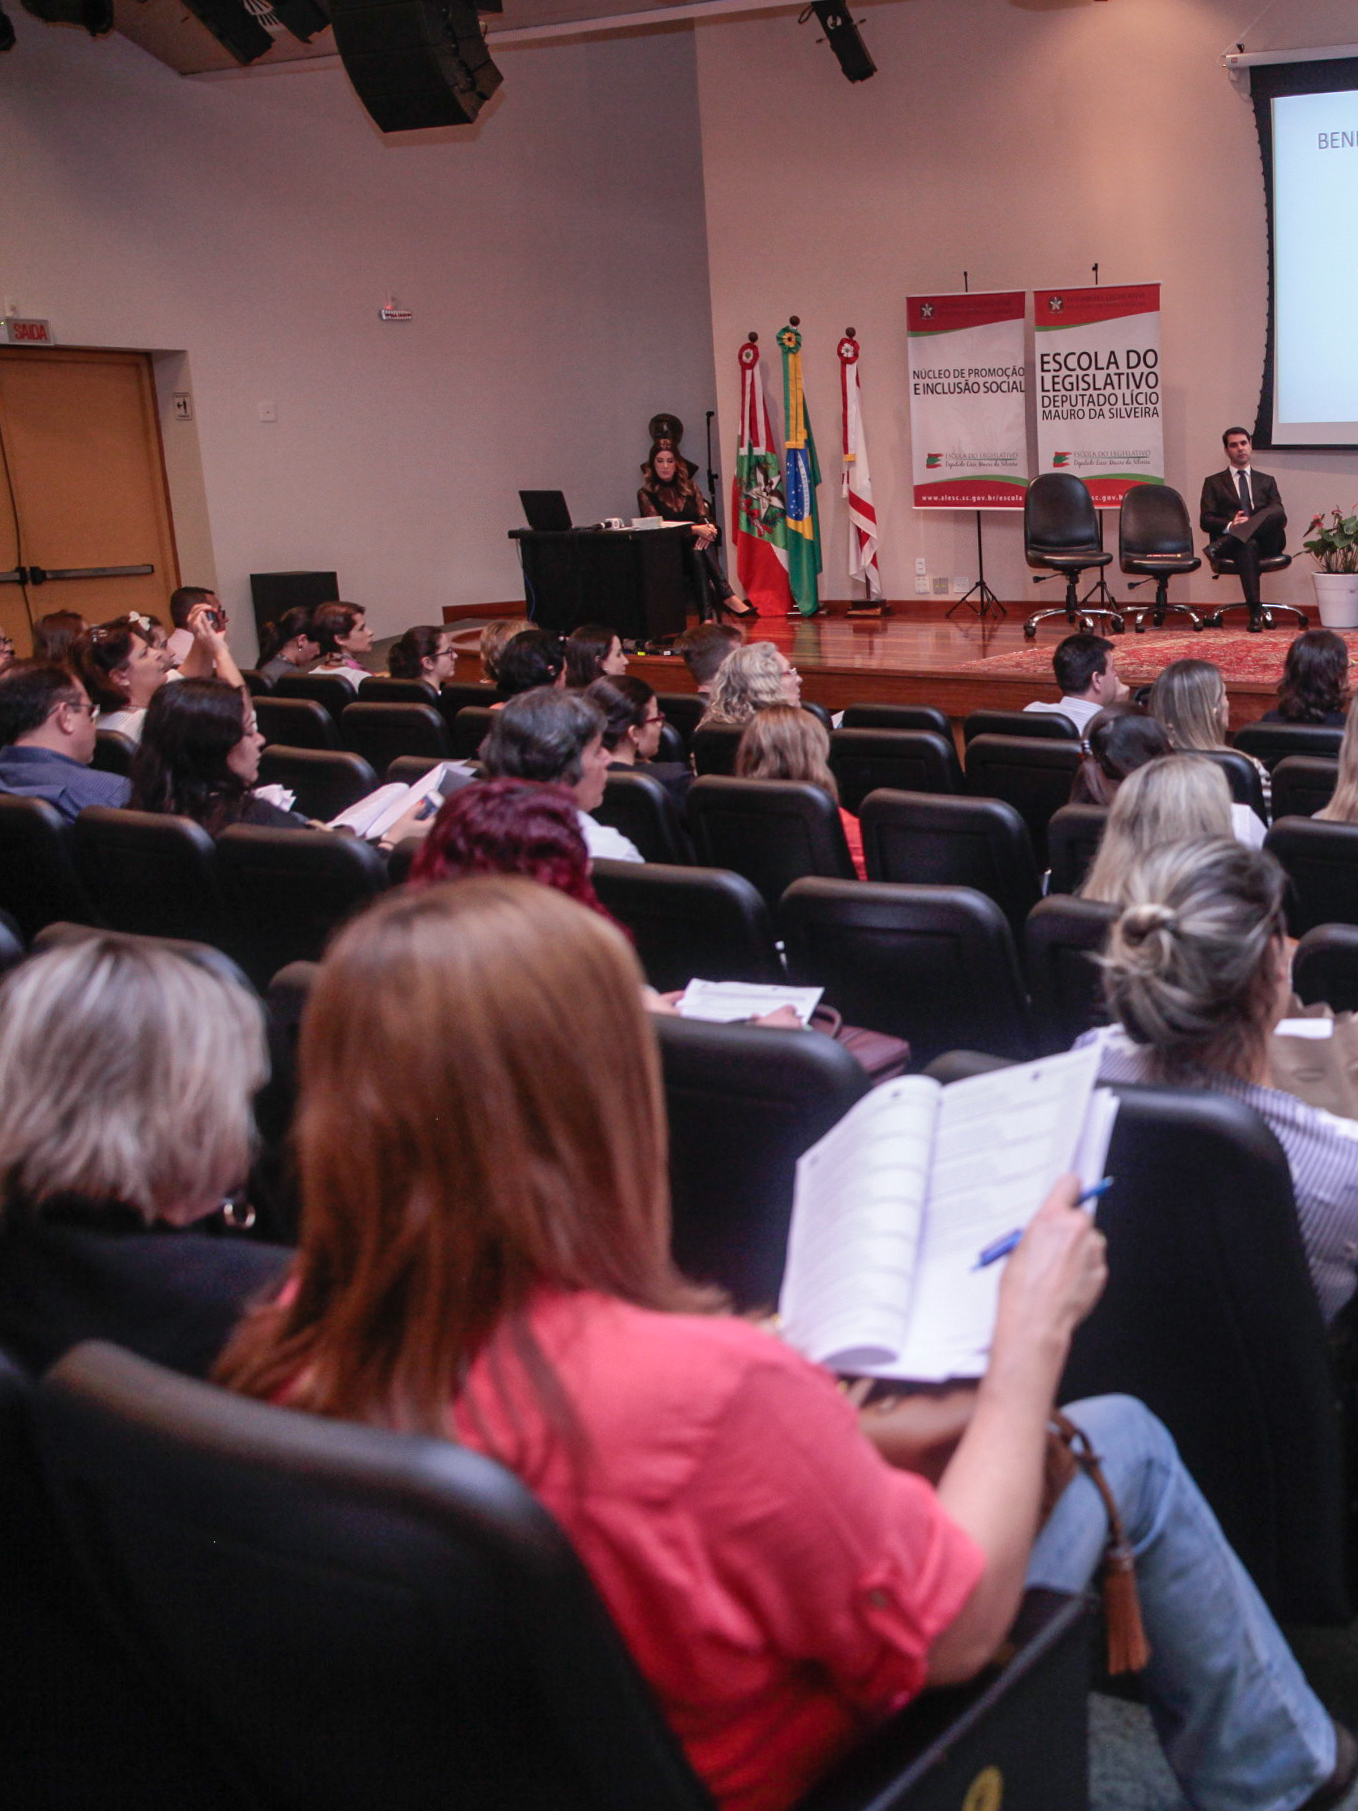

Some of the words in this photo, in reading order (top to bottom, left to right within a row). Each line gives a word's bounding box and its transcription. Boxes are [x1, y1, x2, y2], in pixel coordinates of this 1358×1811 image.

[1040, 350, 1120, 373] ESCOLA
[1126, 348, 1159, 370] DO
[912, 368, 951, 380] NÚCLEO
[953, 368, 966, 378] DE
[967, 365, 1025, 380] PROMOÇÃO
[913, 383, 921, 395] E
[922, 379, 981, 395] INCLUSÃO
[982, 380, 1025, 394] SOCIAL
[1041, 371, 1159, 393] LEGISLATIVO
[1041, 392, 1118, 408] DEPUTADO
[1122, 389, 1160, 406] LÍCIO
[1042, 408, 1086, 421] MAURO
[1088, 408, 1105, 420] DA
[1108, 406, 1160, 419] SILVEIRA
